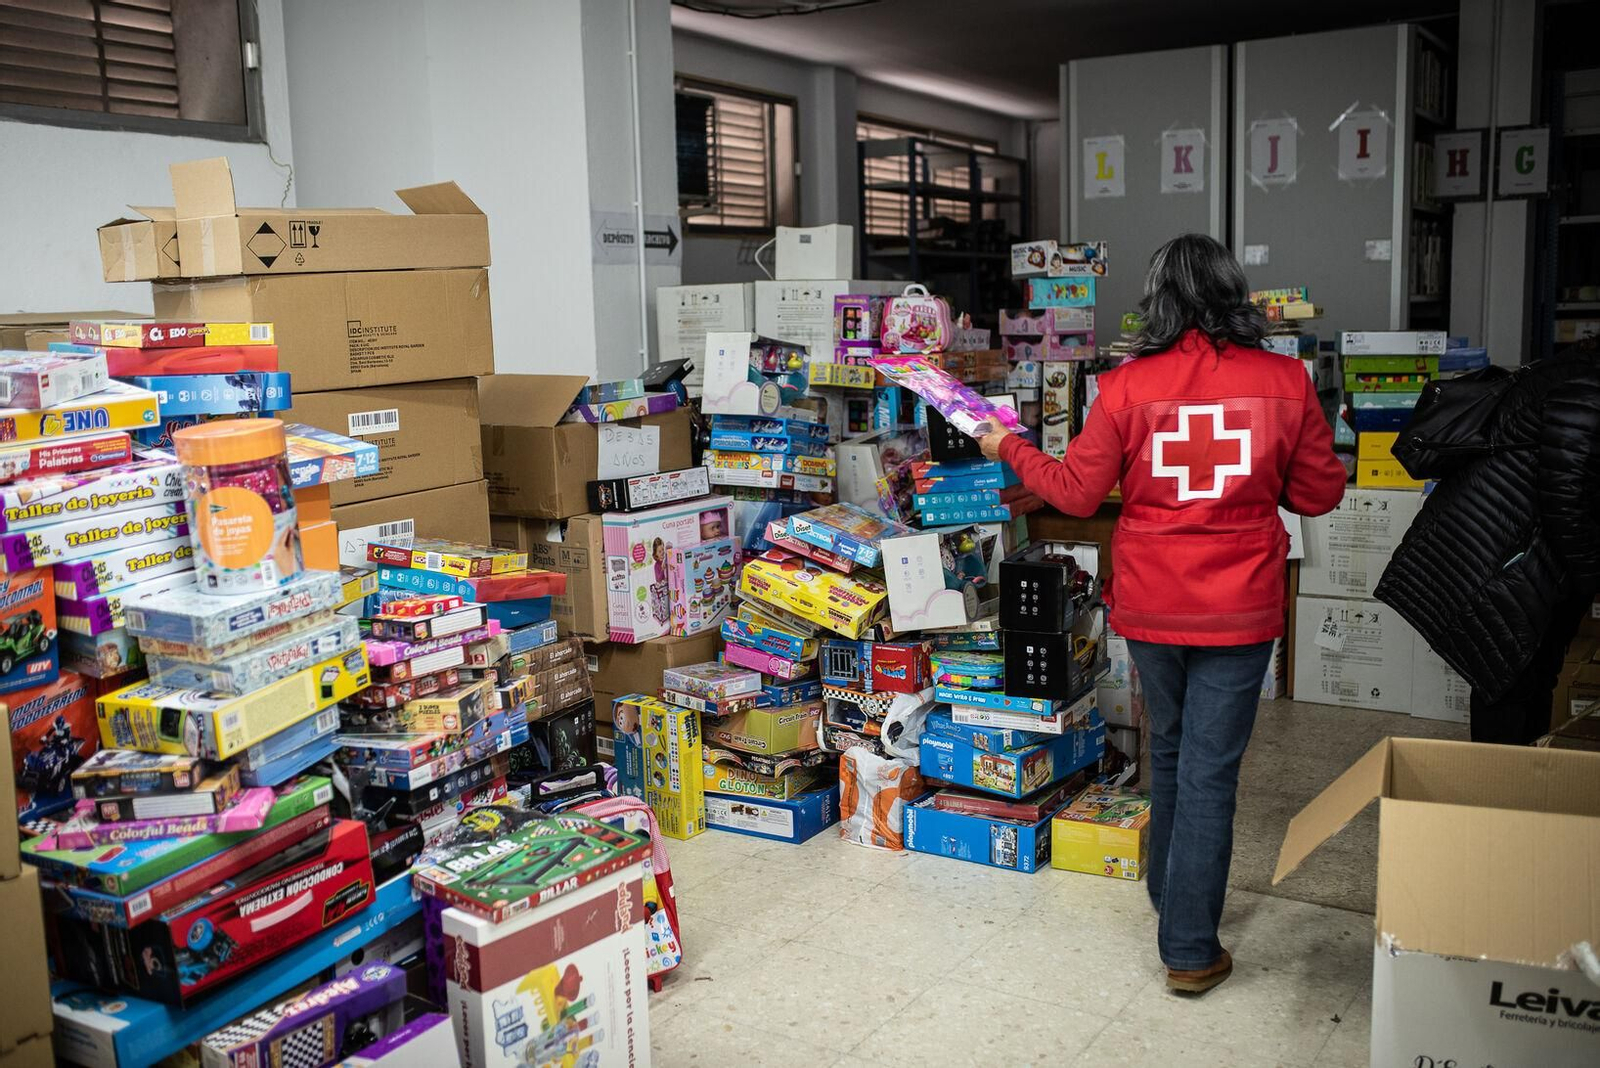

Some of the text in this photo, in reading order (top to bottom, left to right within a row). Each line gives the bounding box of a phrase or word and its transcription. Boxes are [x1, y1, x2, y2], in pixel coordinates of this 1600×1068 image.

[1356, 128, 1370, 159] I
[1173, 145, 1194, 174] K
[1267, 135, 1280, 173] J
[1516, 145, 1535, 175] G
[1095, 152, 1114, 180] L
[1446, 148, 1470, 178] H
[603, 231, 634, 244] DEPÓSITO
[645, 234, 670, 244] RCHIVO
[62, 408, 109, 432] UNE
[605, 428, 622, 442] DE
[628, 432, 634, 442] 3
[52, 447, 81, 456] Primeras
[39, 454, 83, 469] Palabras
[4, 503, 62, 521] Taller
[66, 498, 88, 510] de
[662, 521, 674, 530] Cuna
[796, 524, 811, 533] Diset
[66, 528, 118, 546] Taller
[122, 522, 142, 535] de
[533, 543, 548, 554] ABS
[562, 550, 570, 560] M
[126, 545, 192, 572] Taller de
[533, 554, 556, 566] Pants
[414, 605, 427, 615] UNO
[404, 634, 463, 656] Colorful Beads
[555, 647, 572, 658] ahorcado
[30, 660, 51, 673] UTV
[559, 667, 577, 678] ahorcado
[565, 687, 582, 698] ahorcado
[10, 684, 88, 732] TODOTERRENO
[11, 694, 46, 720] MOTO
[778, 712, 808, 725] Circuit Train
[922, 738, 954, 750] playmobil
[728, 769, 757, 782] DINO
[110, 821, 207, 840] Colorful Beads
[907, 808, 915, 848] playmobil
[446, 839, 518, 874] BILLAR
[539, 876, 578, 902] BILLAR
[239, 889, 286, 918] EXTREMA
[624, 990, 633, 1009] por
[626, 1014, 634, 1025] la
[1550, 1018, 1555, 1028] y
